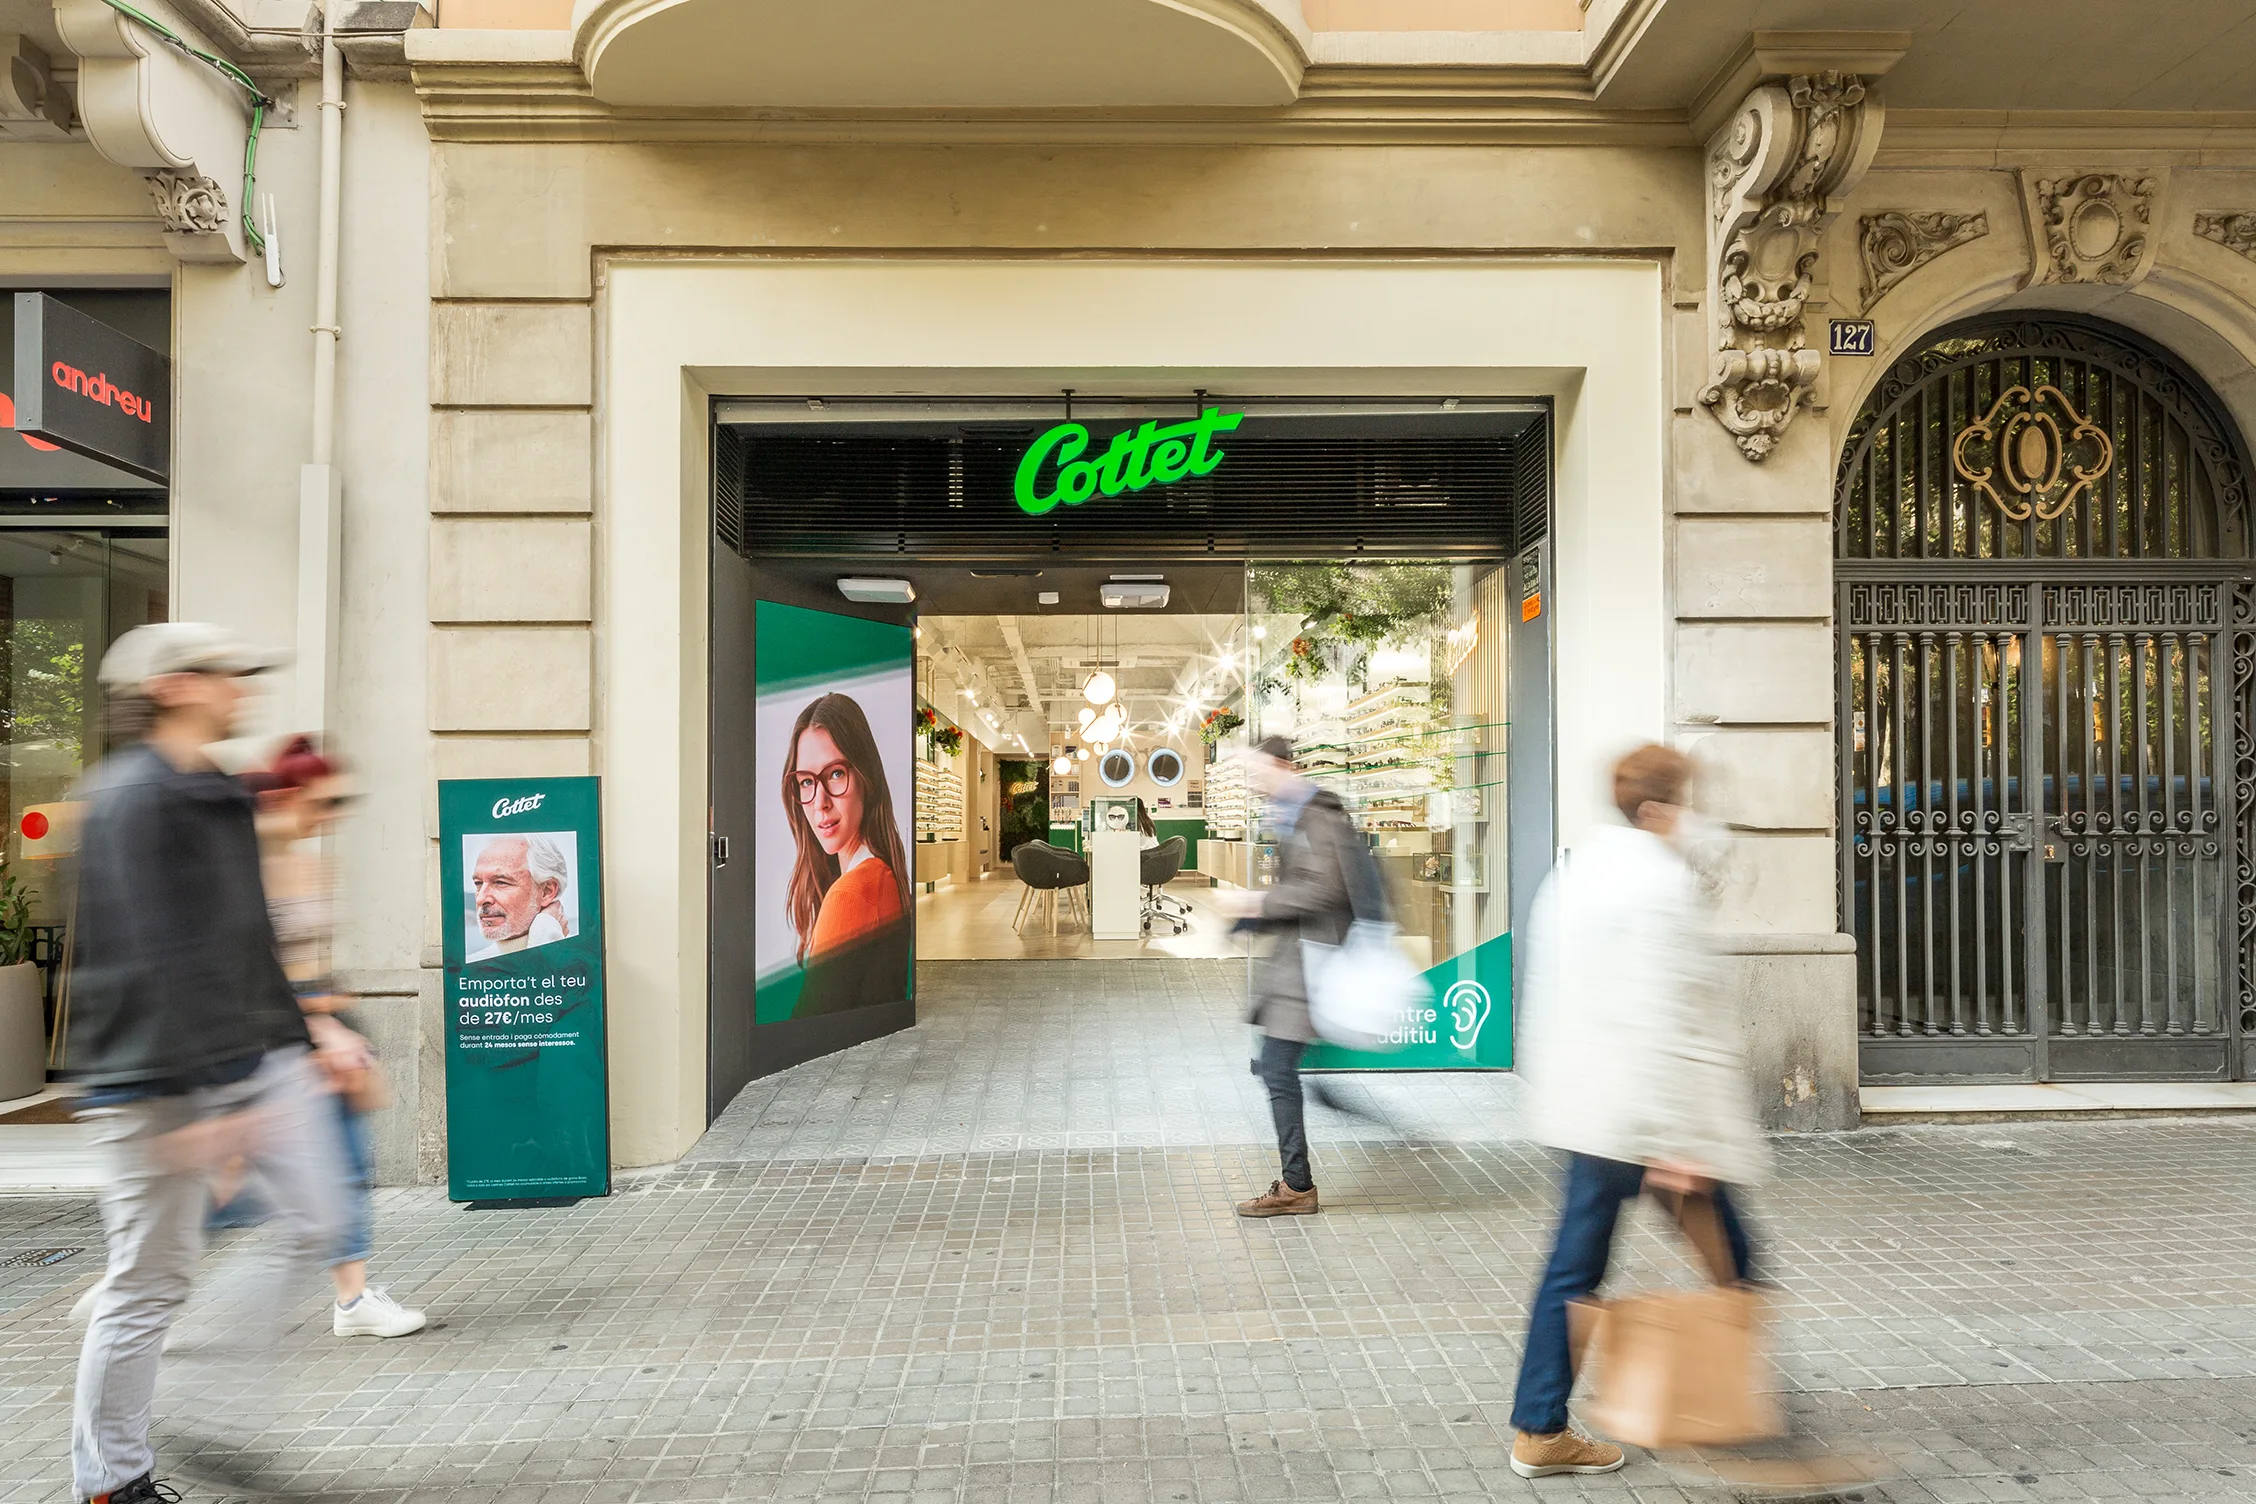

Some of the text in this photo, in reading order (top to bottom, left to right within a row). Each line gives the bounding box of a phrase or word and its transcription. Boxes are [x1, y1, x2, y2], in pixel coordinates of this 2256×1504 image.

[1833, 323, 1870, 351] 127
[51, 361, 152, 423] andreu
[1014, 406, 1245, 515] Cottet
[491, 792, 546, 819] Cottet
[541, 974, 555, 988] el
[560, 975, 586, 988] teu
[459, 992, 563, 1007] audiòfon des
[459, 1010, 553, 1025] de 27€/mes
[1389, 1006, 1437, 1023] ntre
[481, 1033, 509, 1041] entrada
[514, 1034, 532, 1042] paga
[1372, 1025, 1437, 1044] uditiu
